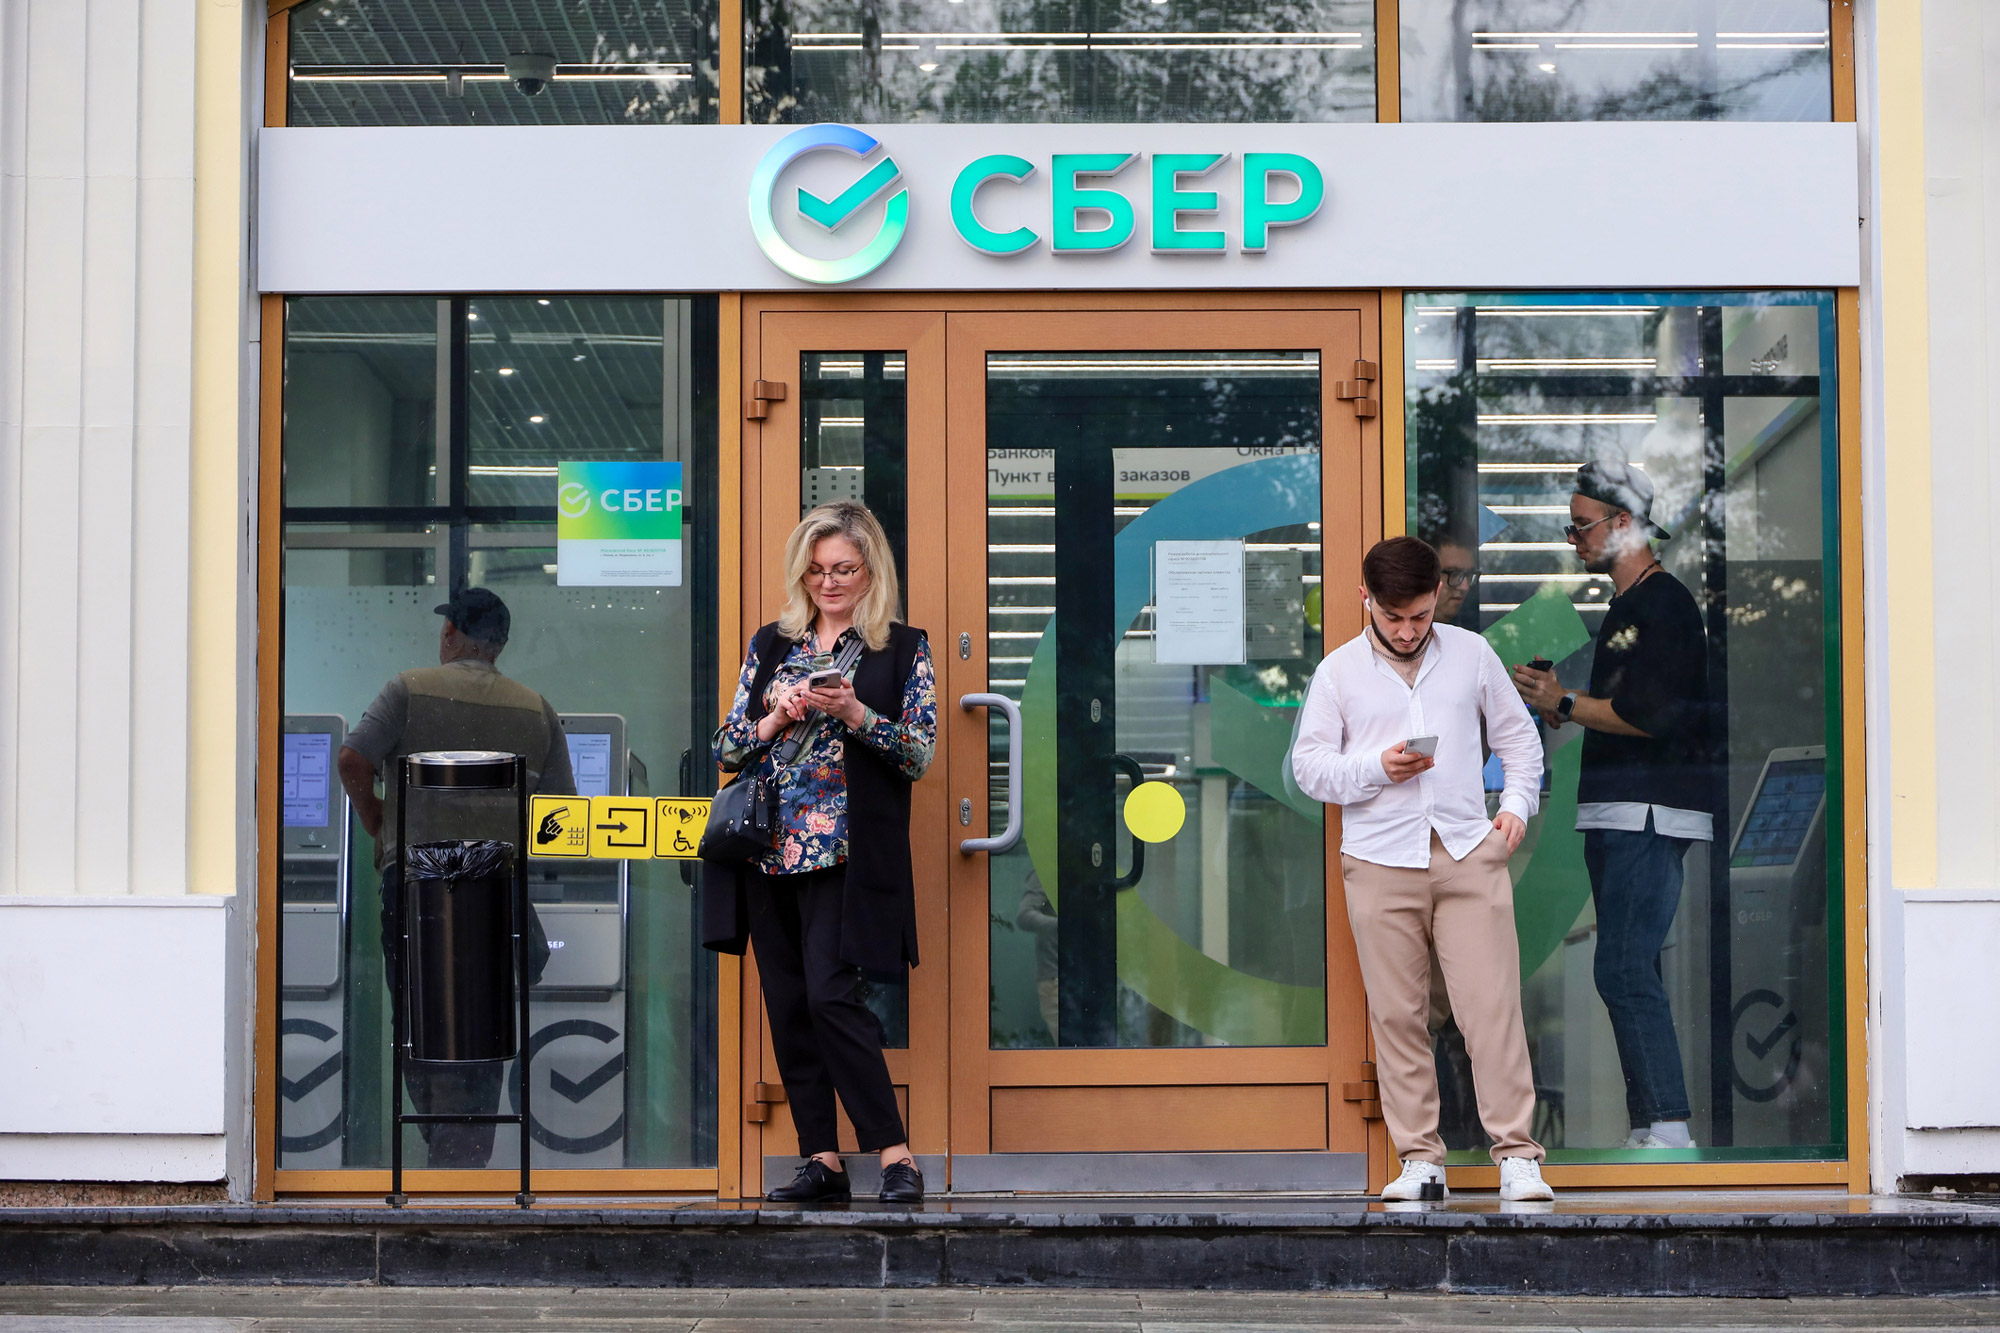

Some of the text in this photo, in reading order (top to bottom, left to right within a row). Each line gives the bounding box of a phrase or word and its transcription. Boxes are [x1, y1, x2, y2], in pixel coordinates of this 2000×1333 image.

[949, 152, 1326, 257] СБЕР
[988, 469, 1041, 486] Пункт
[1119, 470, 1191, 483] заказов
[600, 489, 682, 512] СБЕР
